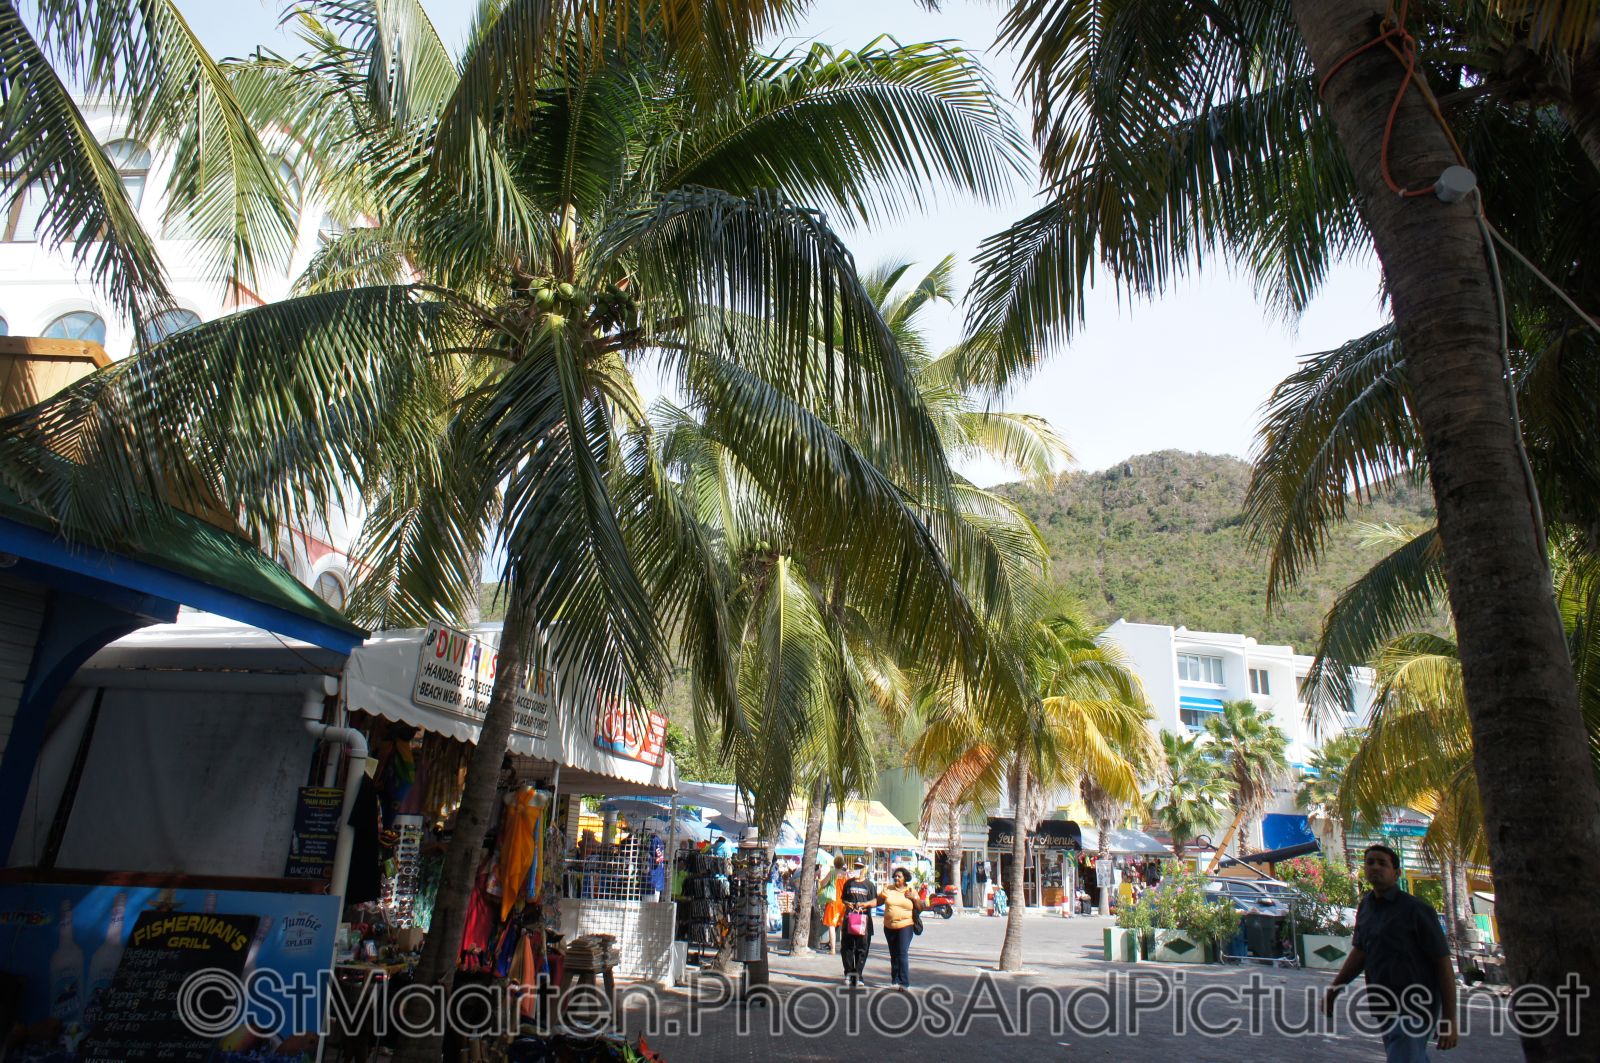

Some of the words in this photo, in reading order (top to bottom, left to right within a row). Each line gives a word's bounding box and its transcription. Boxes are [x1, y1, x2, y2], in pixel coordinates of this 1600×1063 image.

[419, 682, 442, 700] BEACH
[442, 690, 462, 706] WEAR
[282, 914, 322, 932] Jumbie
[133, 915, 247, 951] FISHERMAN'S
[167, 936, 212, 950] GRILL
[285, 937, 313, 948] SPLASH
